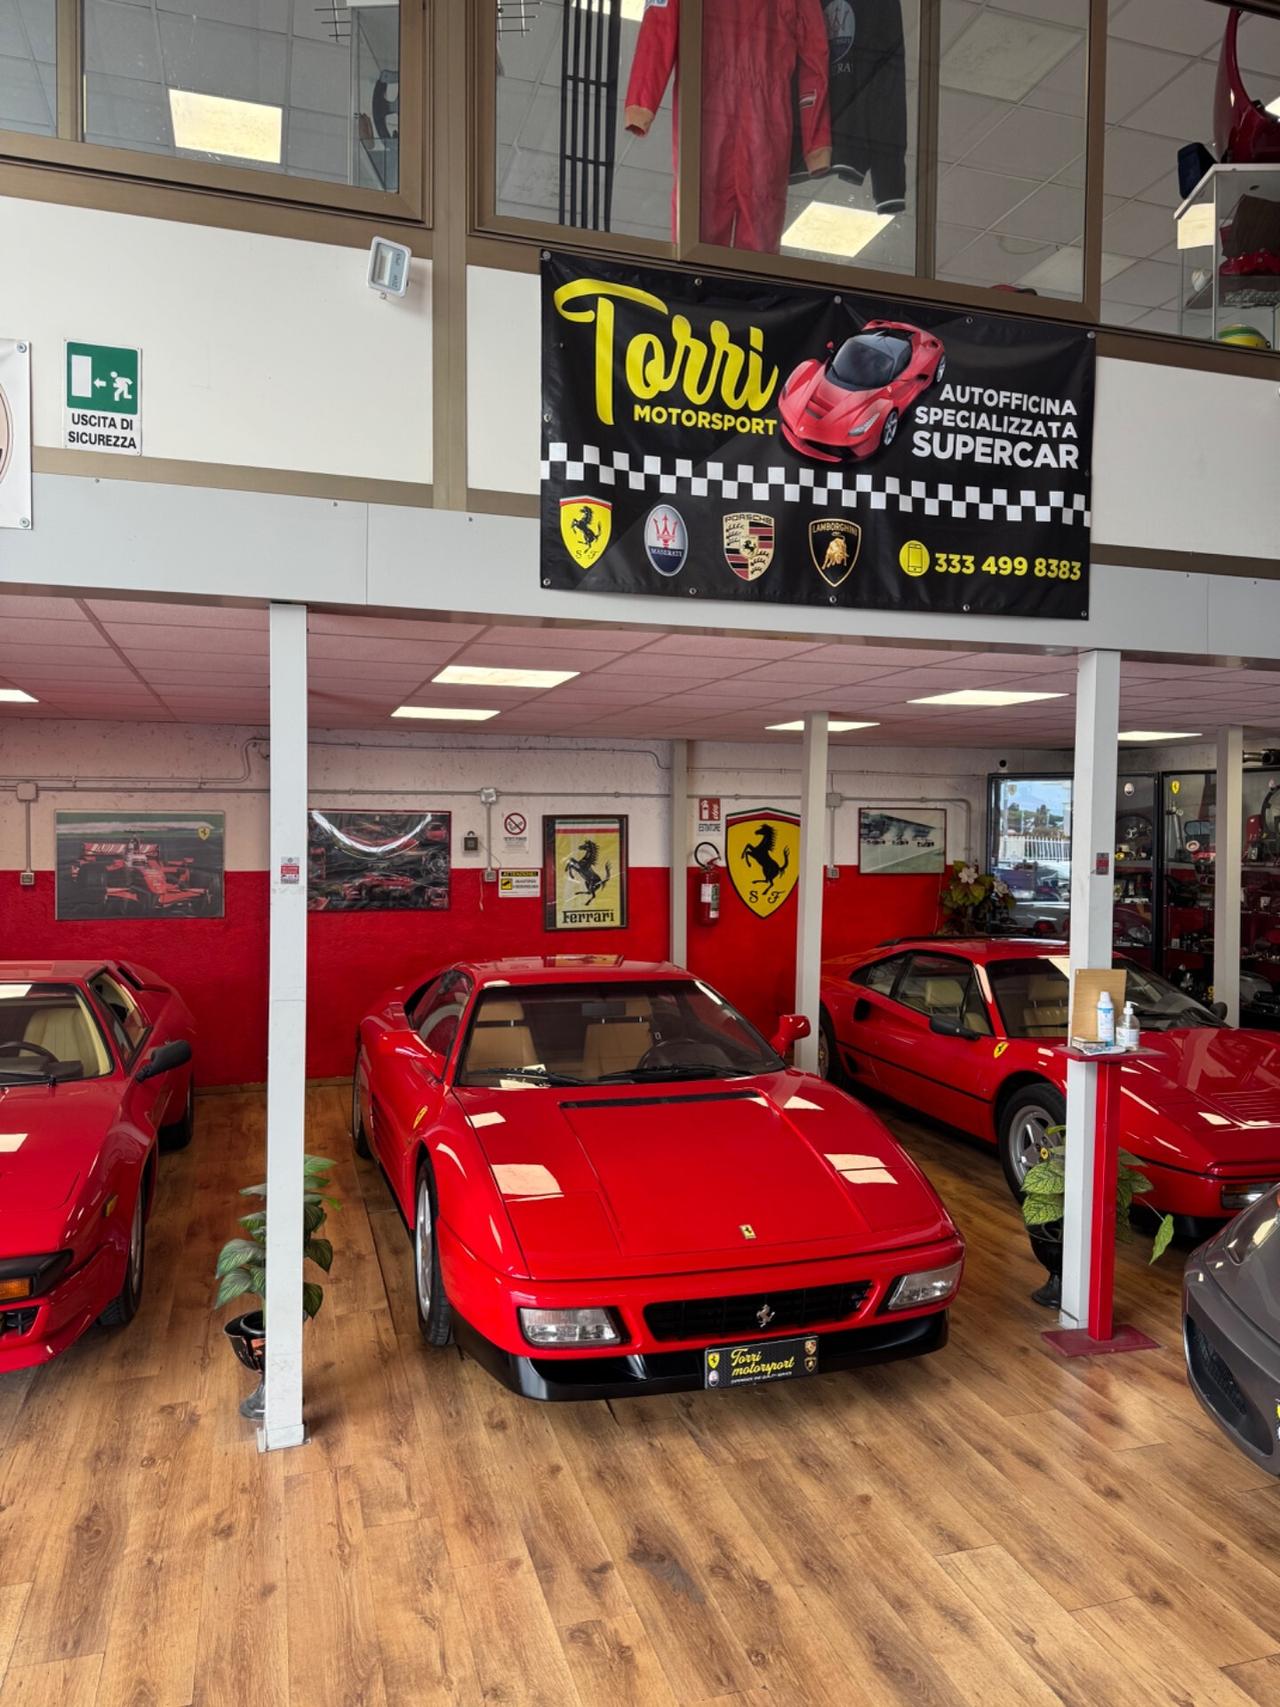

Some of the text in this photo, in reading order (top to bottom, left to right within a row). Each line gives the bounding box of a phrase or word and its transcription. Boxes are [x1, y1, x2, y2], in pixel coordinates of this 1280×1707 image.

[553, 278, 779, 425] Torri
[939, 383, 1078, 416] AUTOFFICINA
[71, 413, 133, 431] USCITA DI
[633, 404, 778, 436] MOTORSPORT
[914, 406, 1078, 438] SPECIALIZZATA
[68, 431, 137, 449] SICUREZZA
[911, 430, 1079, 470] SUPERCAR
[724, 513, 773, 525] PORSCHE
[812, 521, 858, 537] LAMBORGHINI
[934, 553, 1082, 581] 333 499 8383
[749, 890, 759, 903] S
[562, 909, 615, 924] Ferrari
[730, 1348, 762, 1367] Torri
[731, 1356, 795, 1377] motorsport
